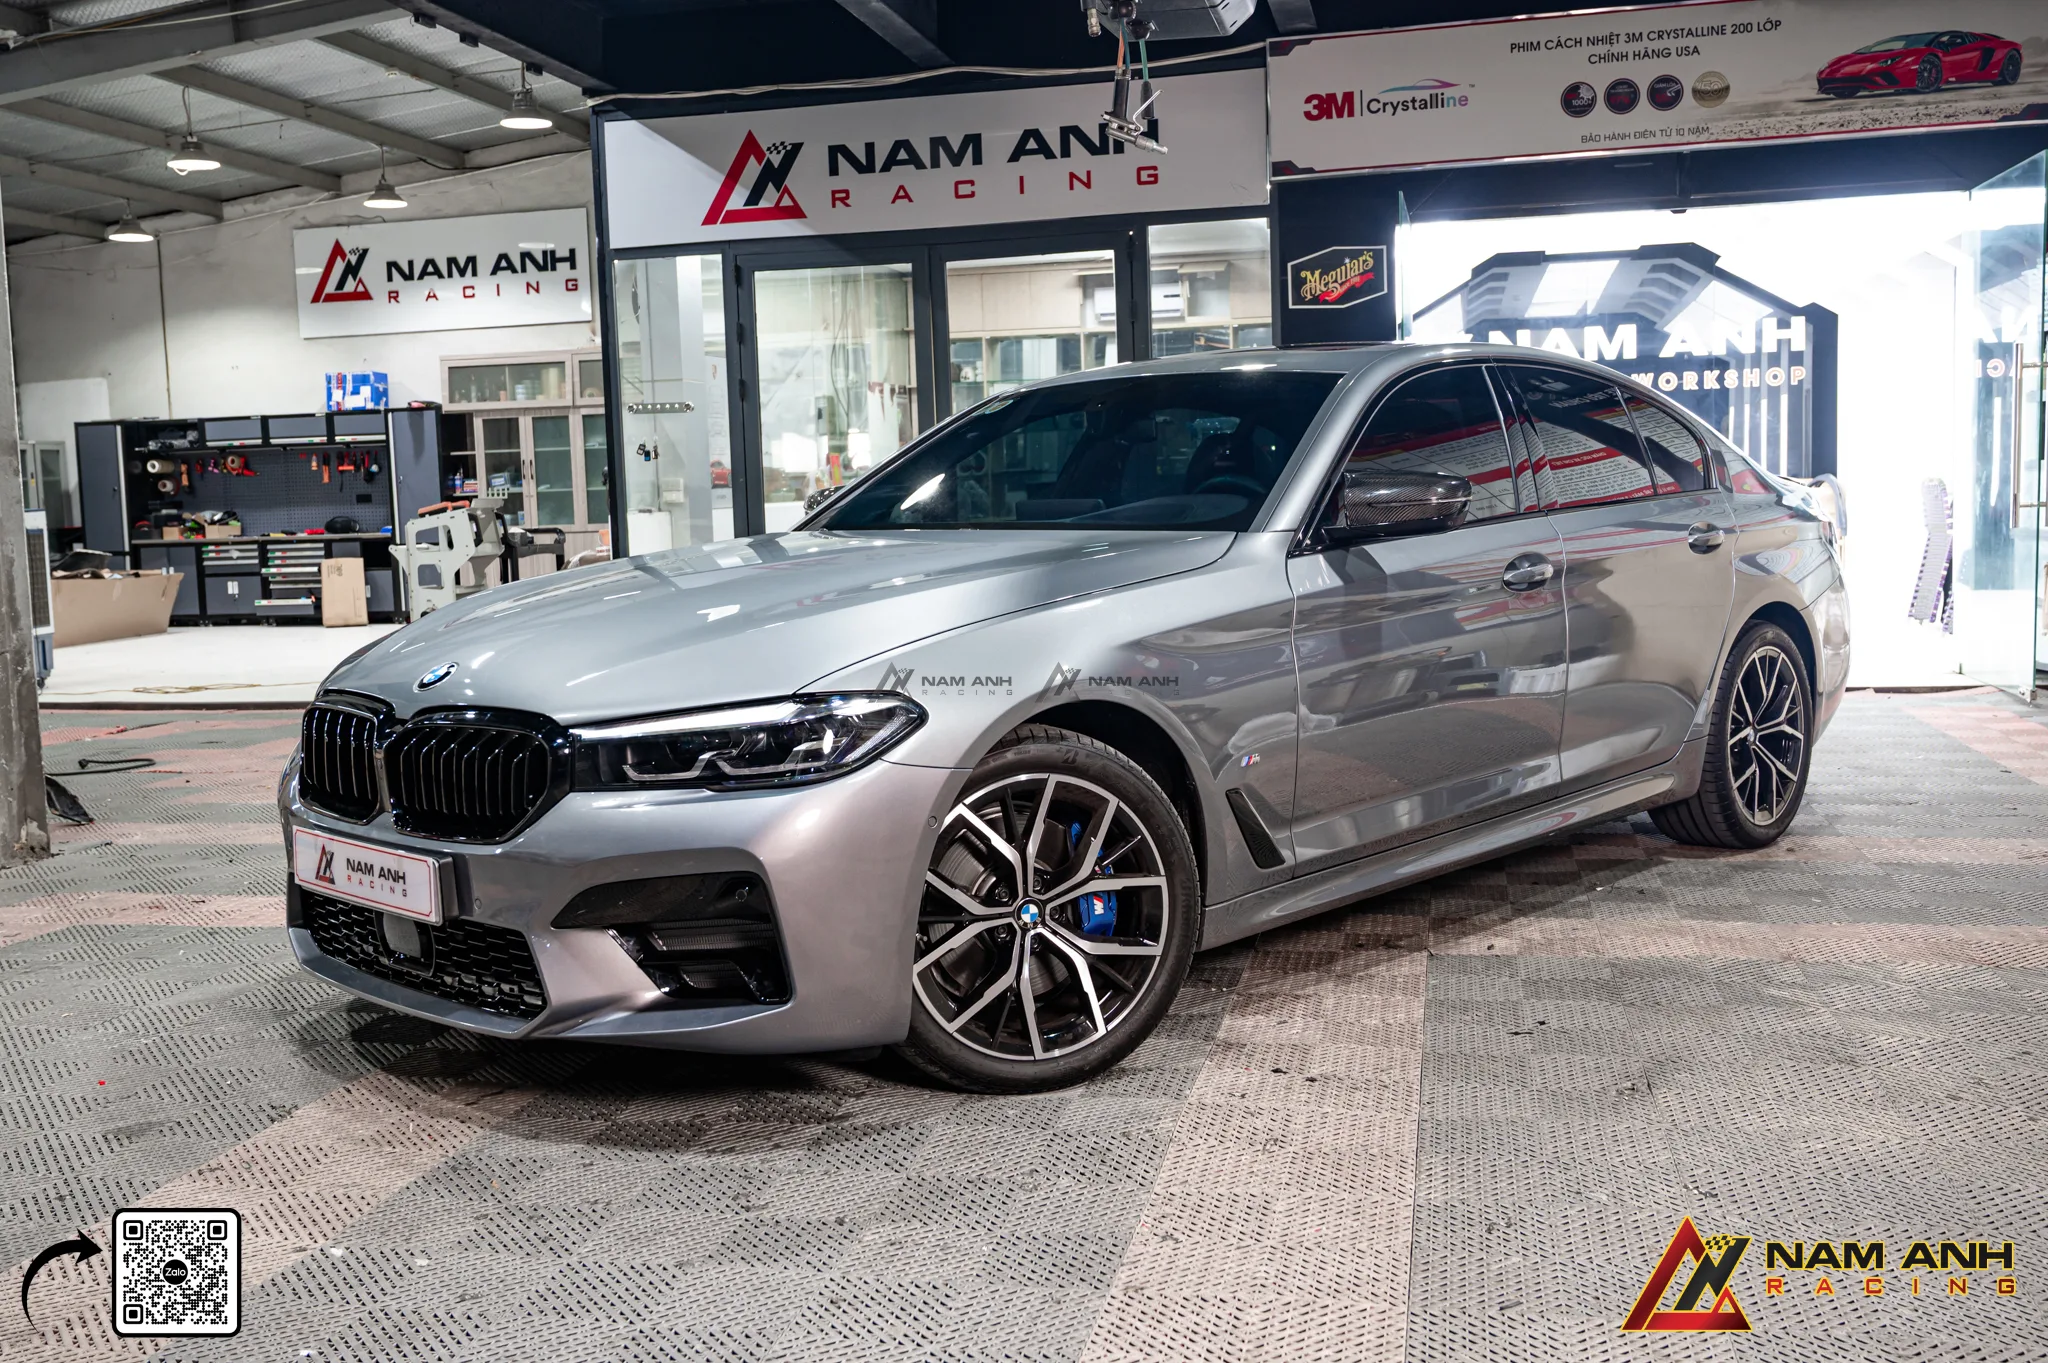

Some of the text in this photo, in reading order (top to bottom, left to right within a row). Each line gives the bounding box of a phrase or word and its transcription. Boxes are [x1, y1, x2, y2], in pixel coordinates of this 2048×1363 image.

[1510, 18, 1782, 53] PHIM CÁCH NHIỆT 3M CRYSTALLINE 200 LỚP
[1588, 45, 1700, 65] CHÍNH HÃNG USA
[1303, 91, 1355, 121] 3M
[1366, 92, 1469, 117] Crystalline
[1581, 132, 1601, 144] BẢO
[1604, 131, 1631, 142] HÀNH
[1634, 129, 1656, 141] ĐIỆN
[1659, 126, 1673, 137] TỬ
[1675, 128, 1685, 137] 10
[828, 132, 983, 177] NAM
[830, 165, 1160, 208] RACING
[386, 247, 577, 283] NAM ANH
[1300, 250, 1374, 301] Meguiar's
[387, 278, 579, 304] RACING
[1658, 315, 1806, 358] ANH
[346, 857, 406, 885] NAM ANH
[347, 874, 408, 898] RACING
